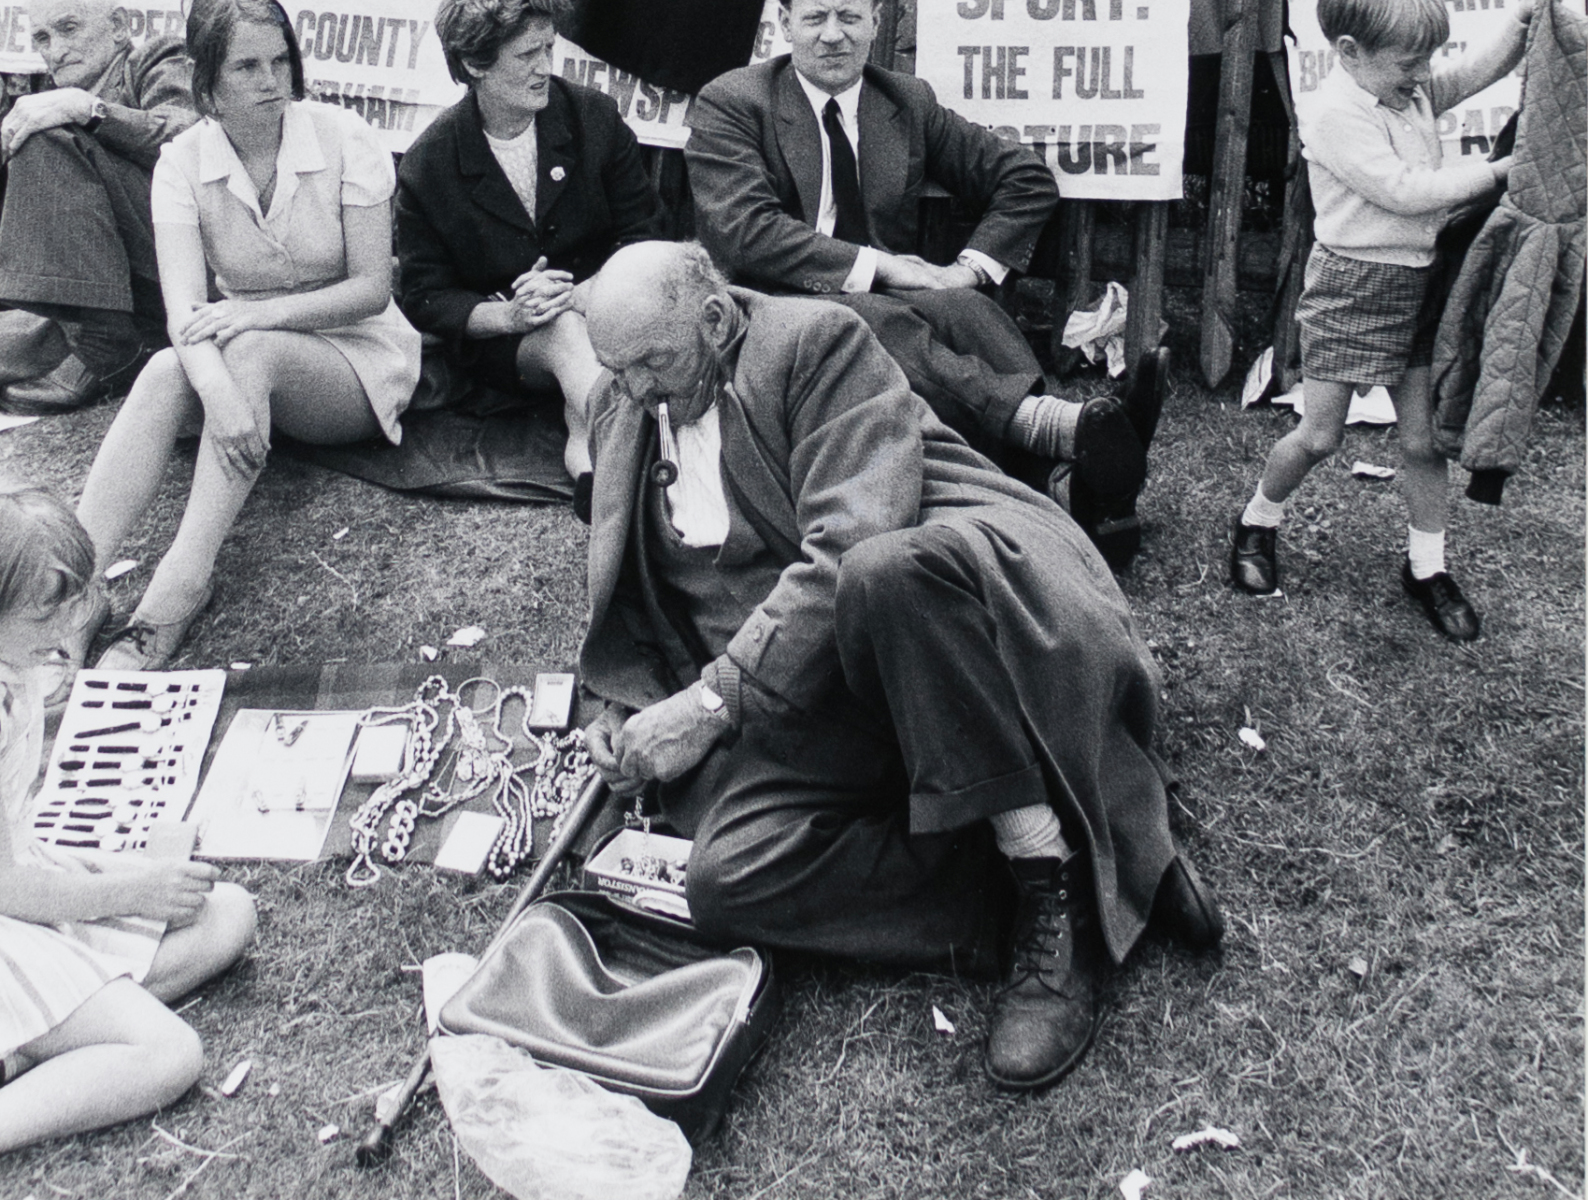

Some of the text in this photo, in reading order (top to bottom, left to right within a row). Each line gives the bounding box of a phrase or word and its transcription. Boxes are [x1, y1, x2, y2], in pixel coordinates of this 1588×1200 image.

[297, 9, 430, 70] COUNTY
[957, 45, 1145, 100] THE FULL
